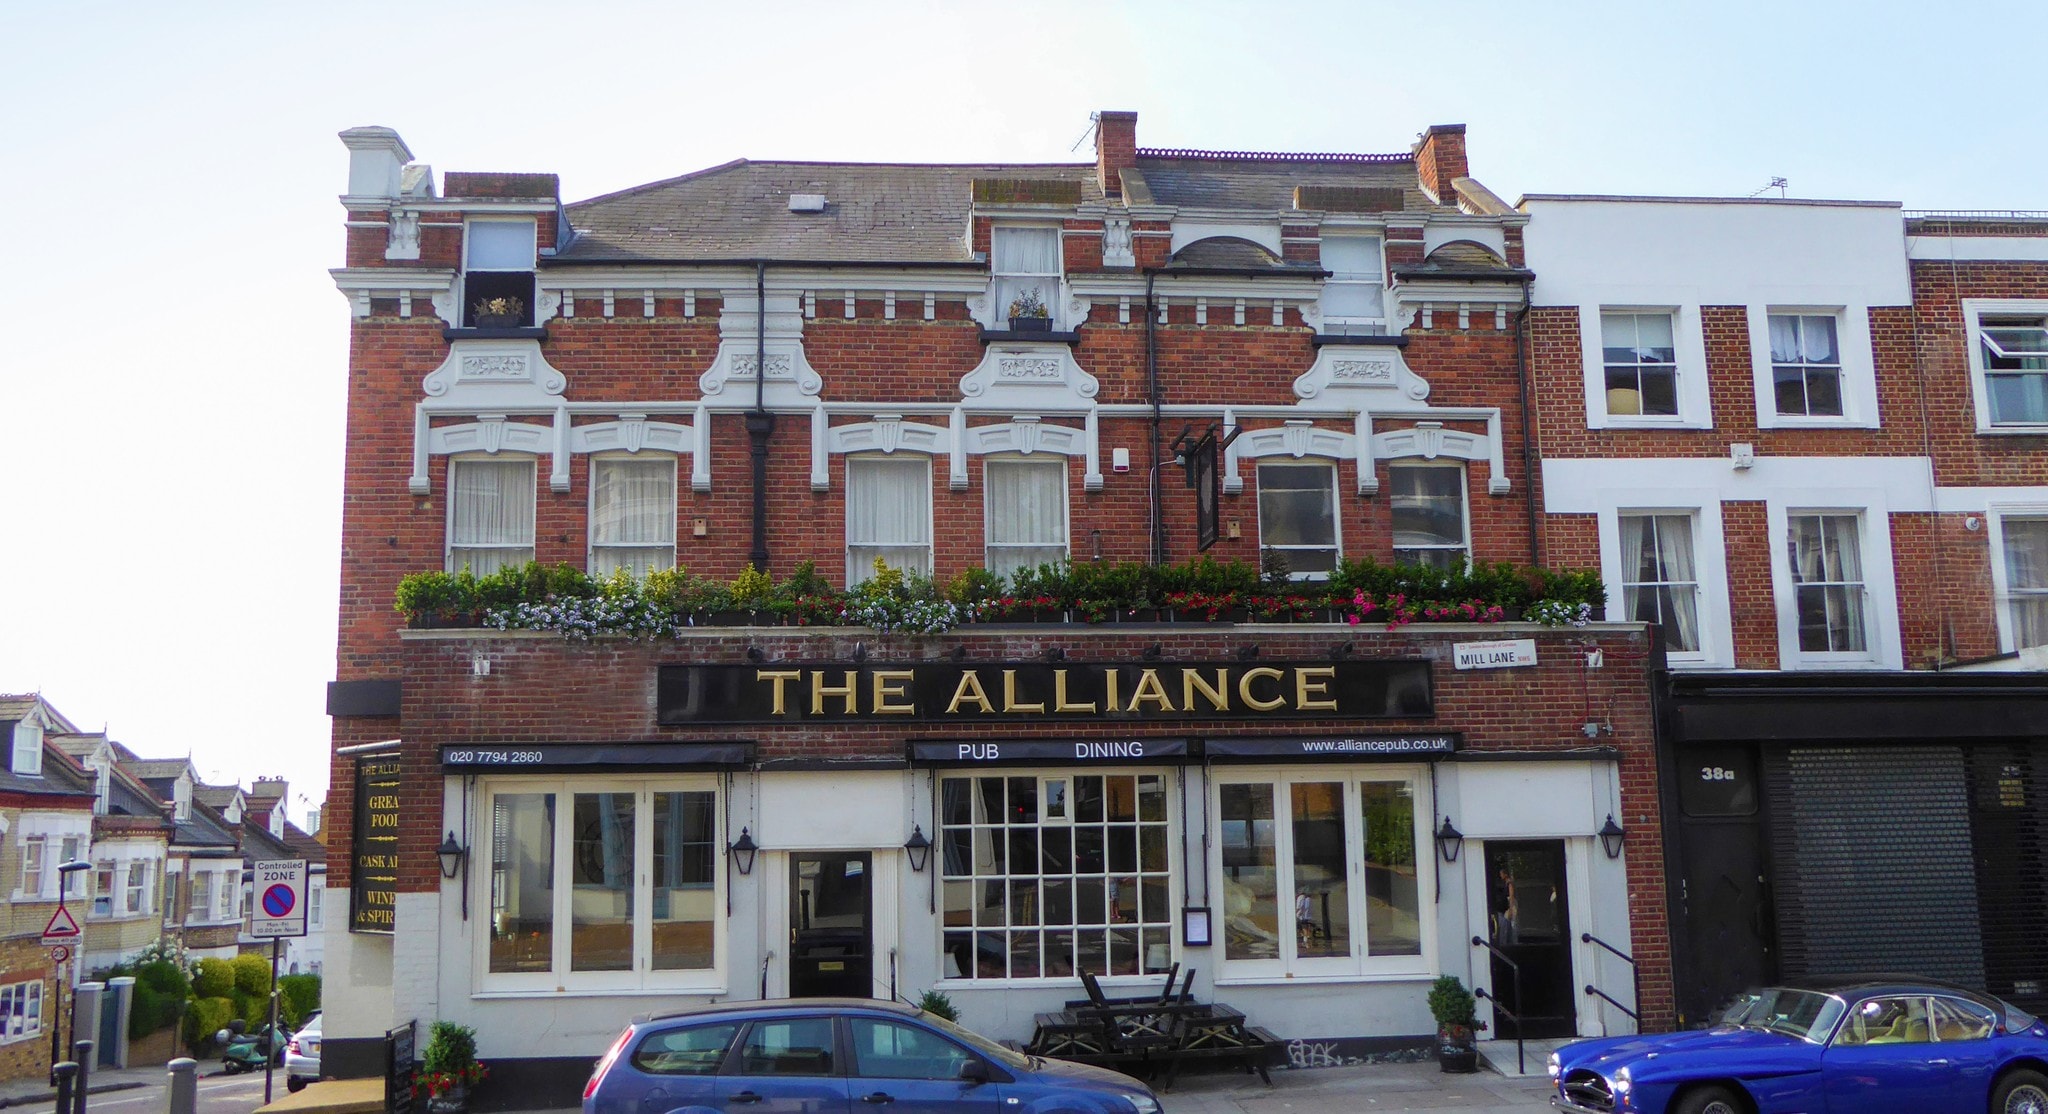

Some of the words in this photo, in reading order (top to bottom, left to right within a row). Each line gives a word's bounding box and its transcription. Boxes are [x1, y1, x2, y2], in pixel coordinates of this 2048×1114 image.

[1461, 654, 1486, 665] MILL
[1488, 652, 1515, 664] LANE
[757, 668, 915, 715] THE
[945, 666, 1338, 714] ALLIANCE
[958, 743, 999, 760] PUB
[1075, 741, 1143, 758] DINING
[1302, 737, 1448, 753] www.alliancepub.co.uk
[450, 751, 474, 763] 020
[477, 751, 508, 763] 7794
[511, 751, 543, 763] 2860
[361, 765, 377, 776] THE
[1701, 766, 1735, 780] 38a
[258, 861, 303, 870] Controlled
[360, 855, 386, 868] CASK
[264, 871, 296, 881] ZONE
[357, 911, 366, 922] &
